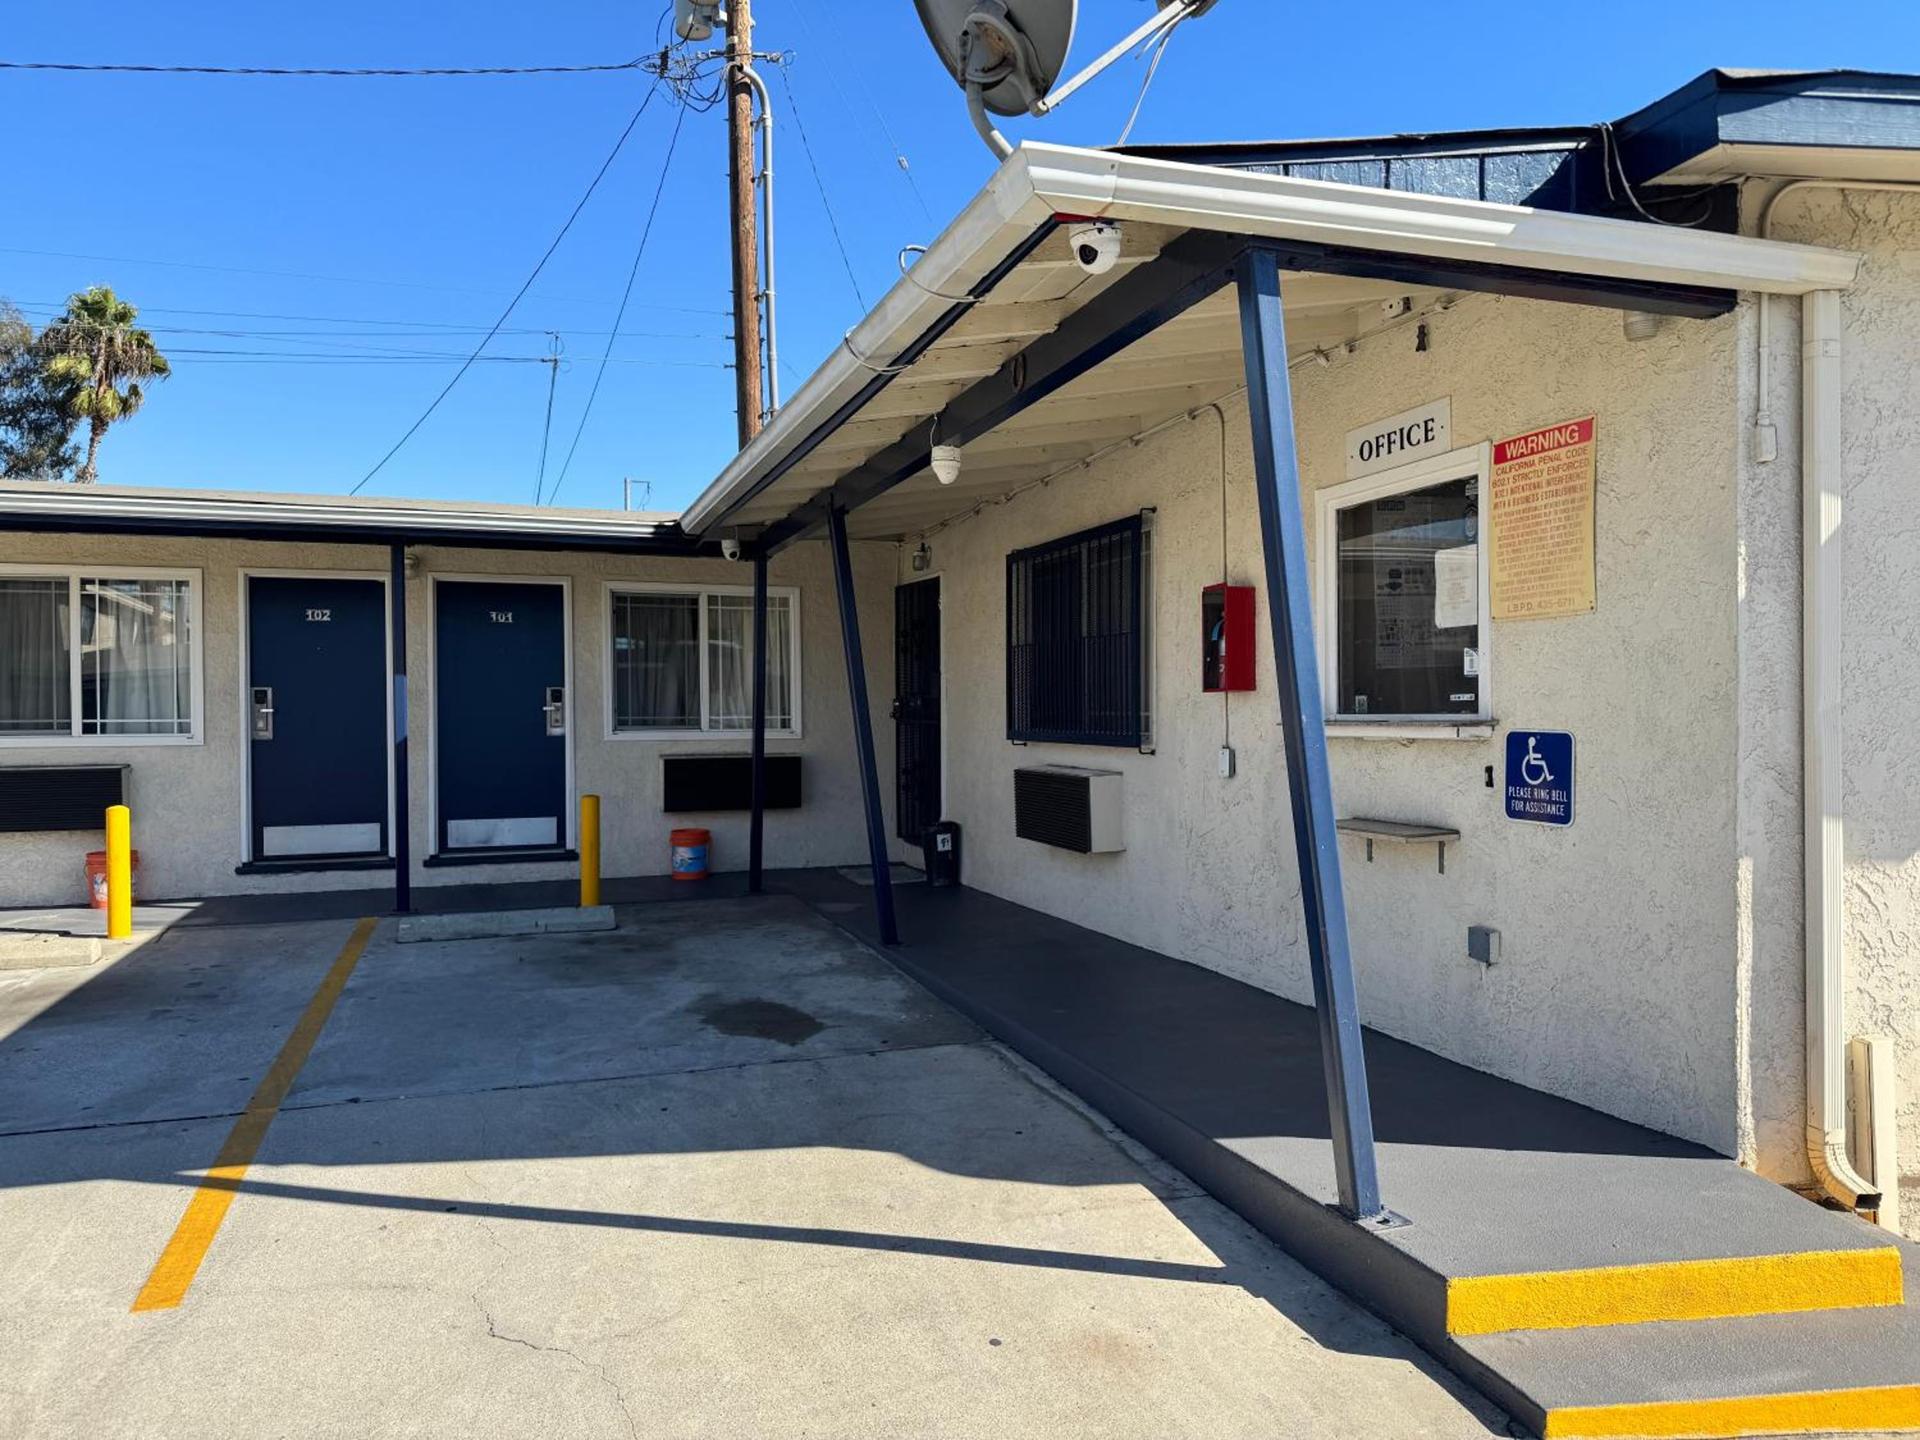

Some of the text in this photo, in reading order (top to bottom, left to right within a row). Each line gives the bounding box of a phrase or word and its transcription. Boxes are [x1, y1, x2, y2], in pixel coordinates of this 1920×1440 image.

[1359, 417, 1435, 462] OFFICE
[1505, 425, 1579, 459] WARNING
[1495, 447, 1589, 476] CALIFORNIA PENAL CODE
[1512, 469, 1544, 484] STRICTLY
[1547, 458, 1590, 476] ENFORCED
[306, 609, 331, 622] 102
[490, 611, 513, 623] 101
[1508, 786, 1568, 802] PLEASE RING BELL
[1511, 799, 1565, 816] FOR ASSISTANCE
